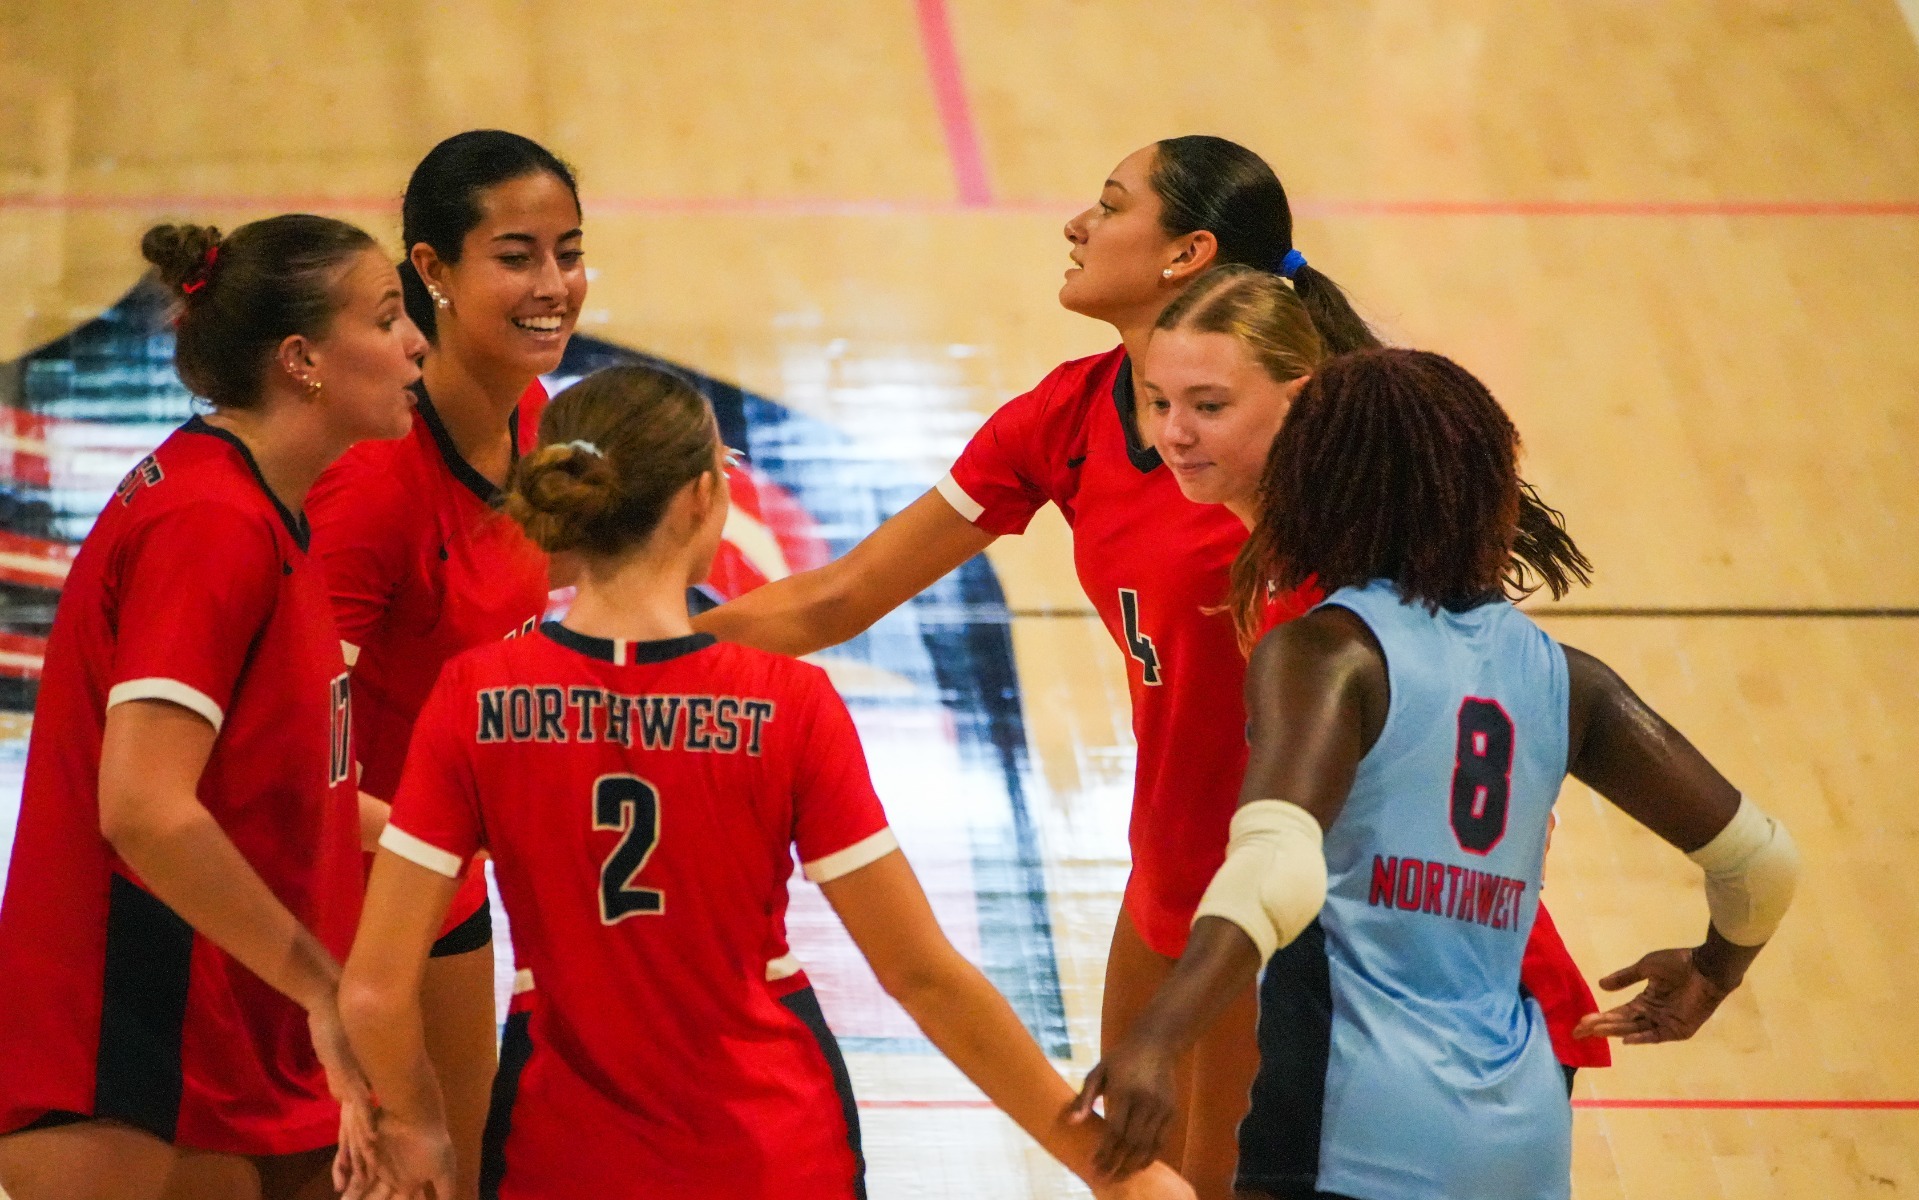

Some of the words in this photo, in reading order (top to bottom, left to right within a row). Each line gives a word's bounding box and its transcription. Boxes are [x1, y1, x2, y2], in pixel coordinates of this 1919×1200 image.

[1118, 587, 1163, 686] 4
[329, 671, 351, 789] 17
[476, 684, 775, 757] NORTHWEST
[1450, 696, 1515, 857] 8
[592, 772, 666, 926] 2
